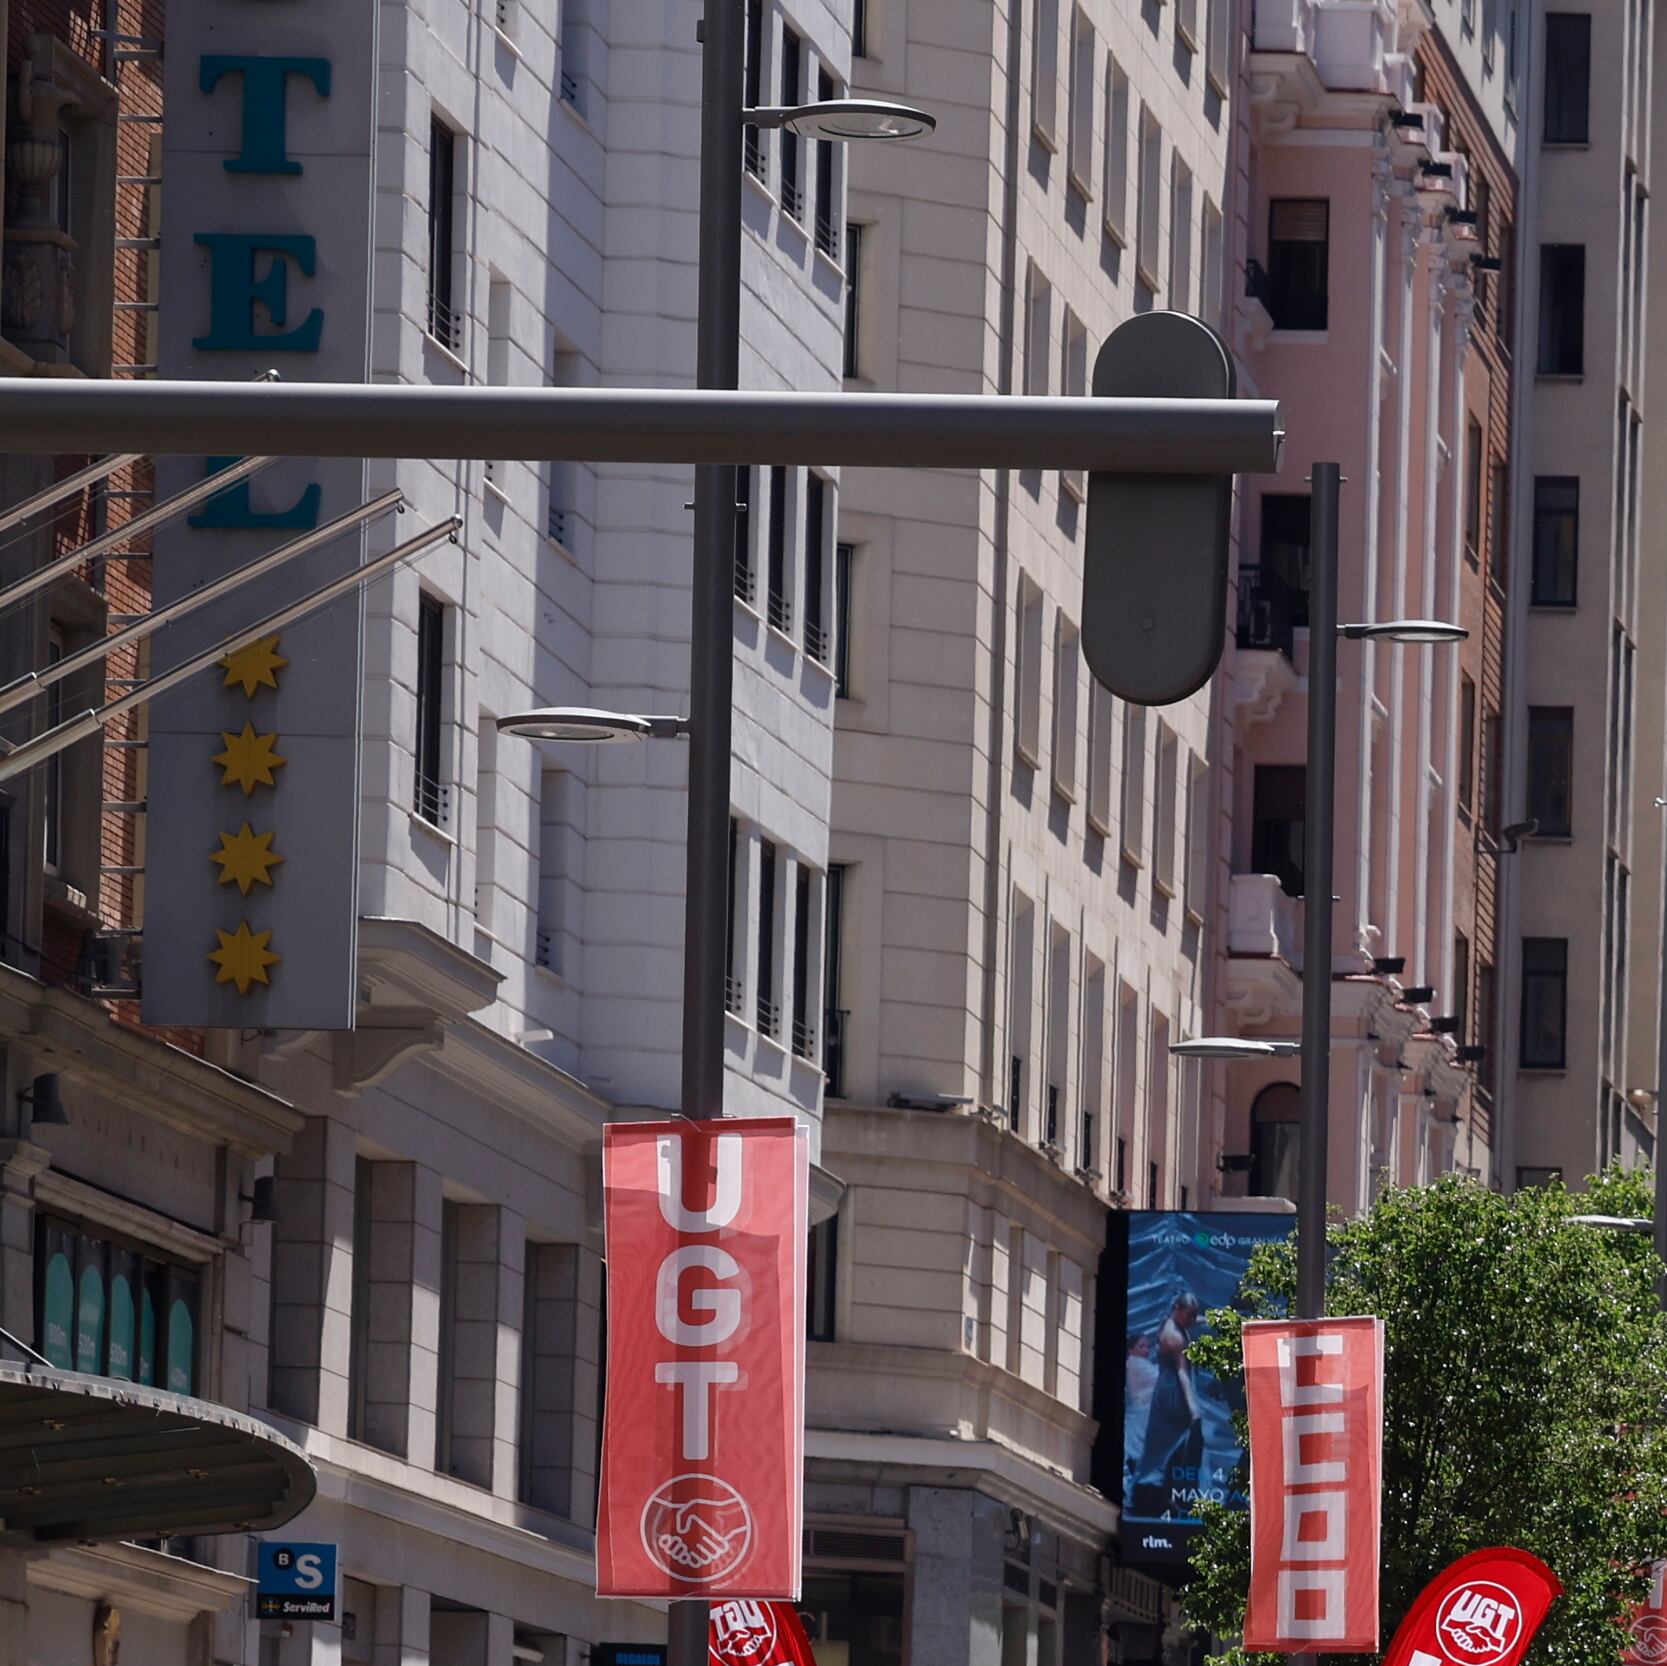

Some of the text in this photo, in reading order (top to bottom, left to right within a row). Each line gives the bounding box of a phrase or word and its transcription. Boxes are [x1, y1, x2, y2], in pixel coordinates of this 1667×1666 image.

[1210, 1234, 1235, 1248] edp
[656, 1134, 746, 1460] UGT
[1212, 1468, 1224, 1482] 4
[1277, 1334, 1345, 1640] CCOO
[1171, 1487, 1225, 1502] MAYO
[278, 1554, 323, 1589] B S
[283, 1602, 331, 1614] ServiRed
[1437, 1589, 1517, 1645] UGT
